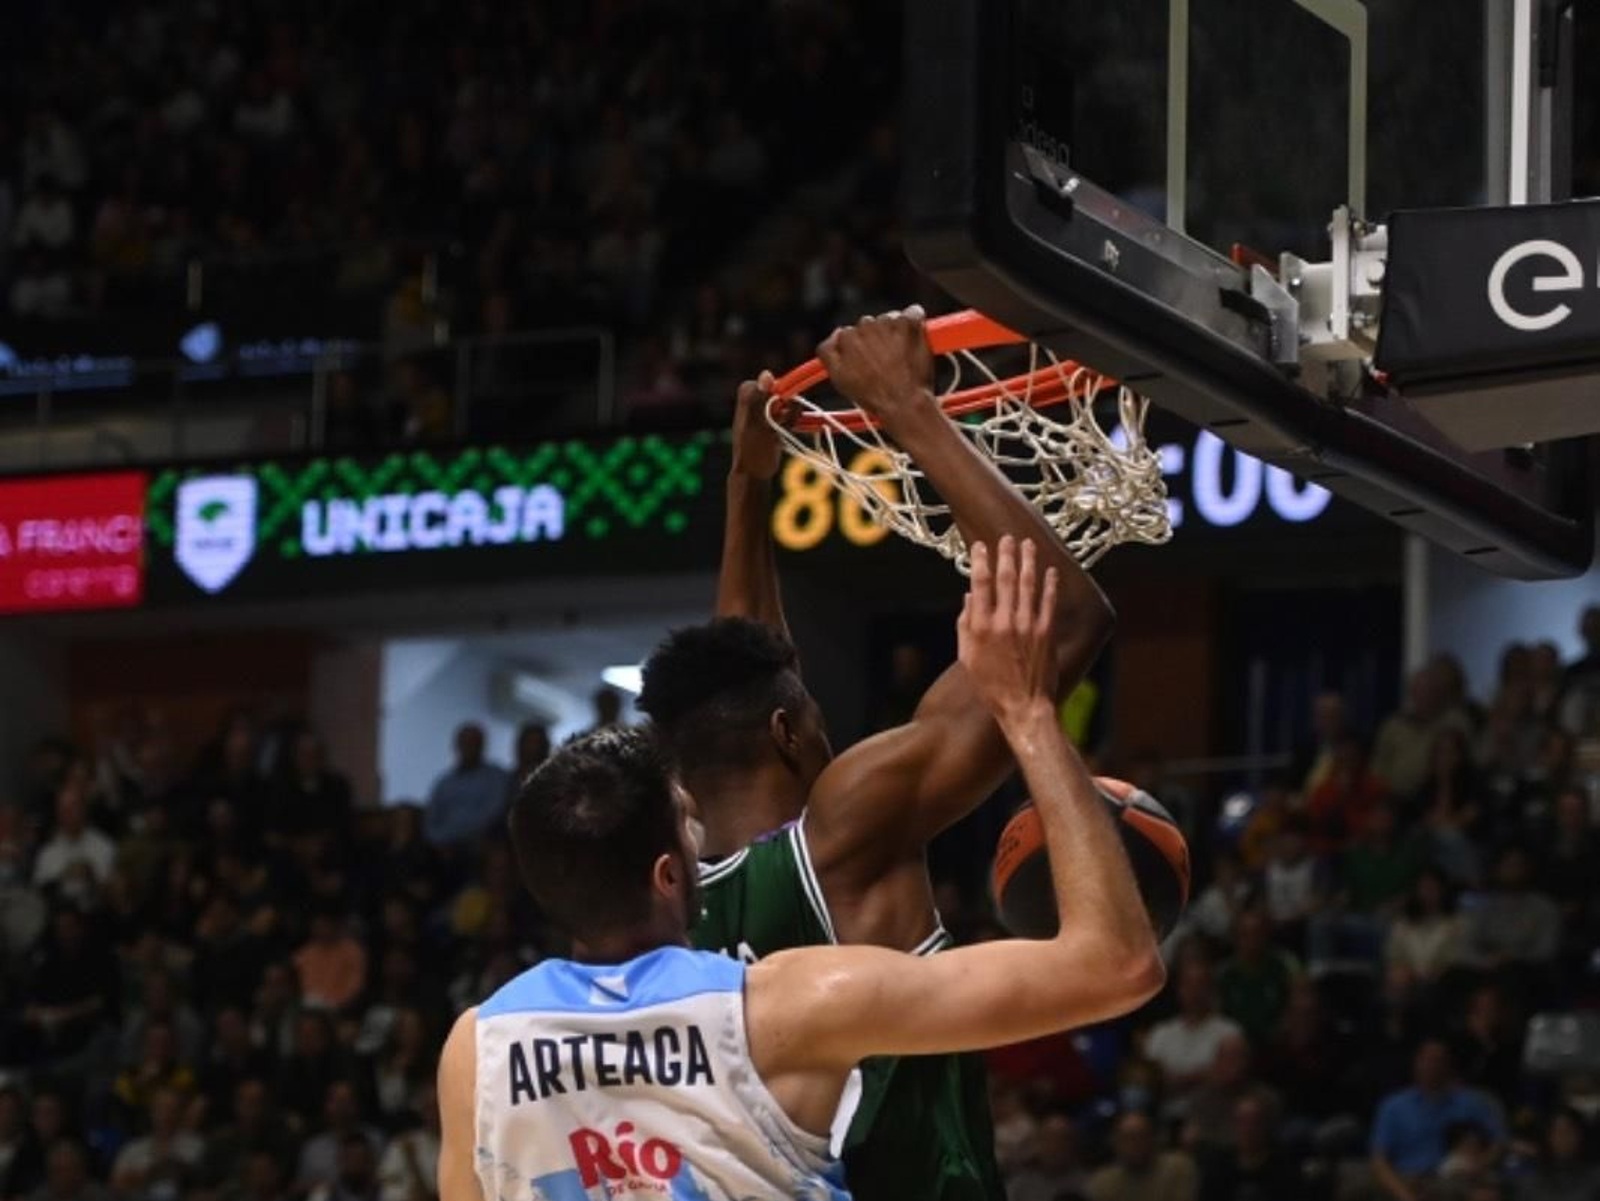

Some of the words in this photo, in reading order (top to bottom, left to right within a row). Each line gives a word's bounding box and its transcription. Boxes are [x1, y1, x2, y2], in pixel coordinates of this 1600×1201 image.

[1488, 240, 1600, 331] e
[303, 484, 563, 555] UNICAJA
[509, 1025, 715, 1106] ARTEAGA
